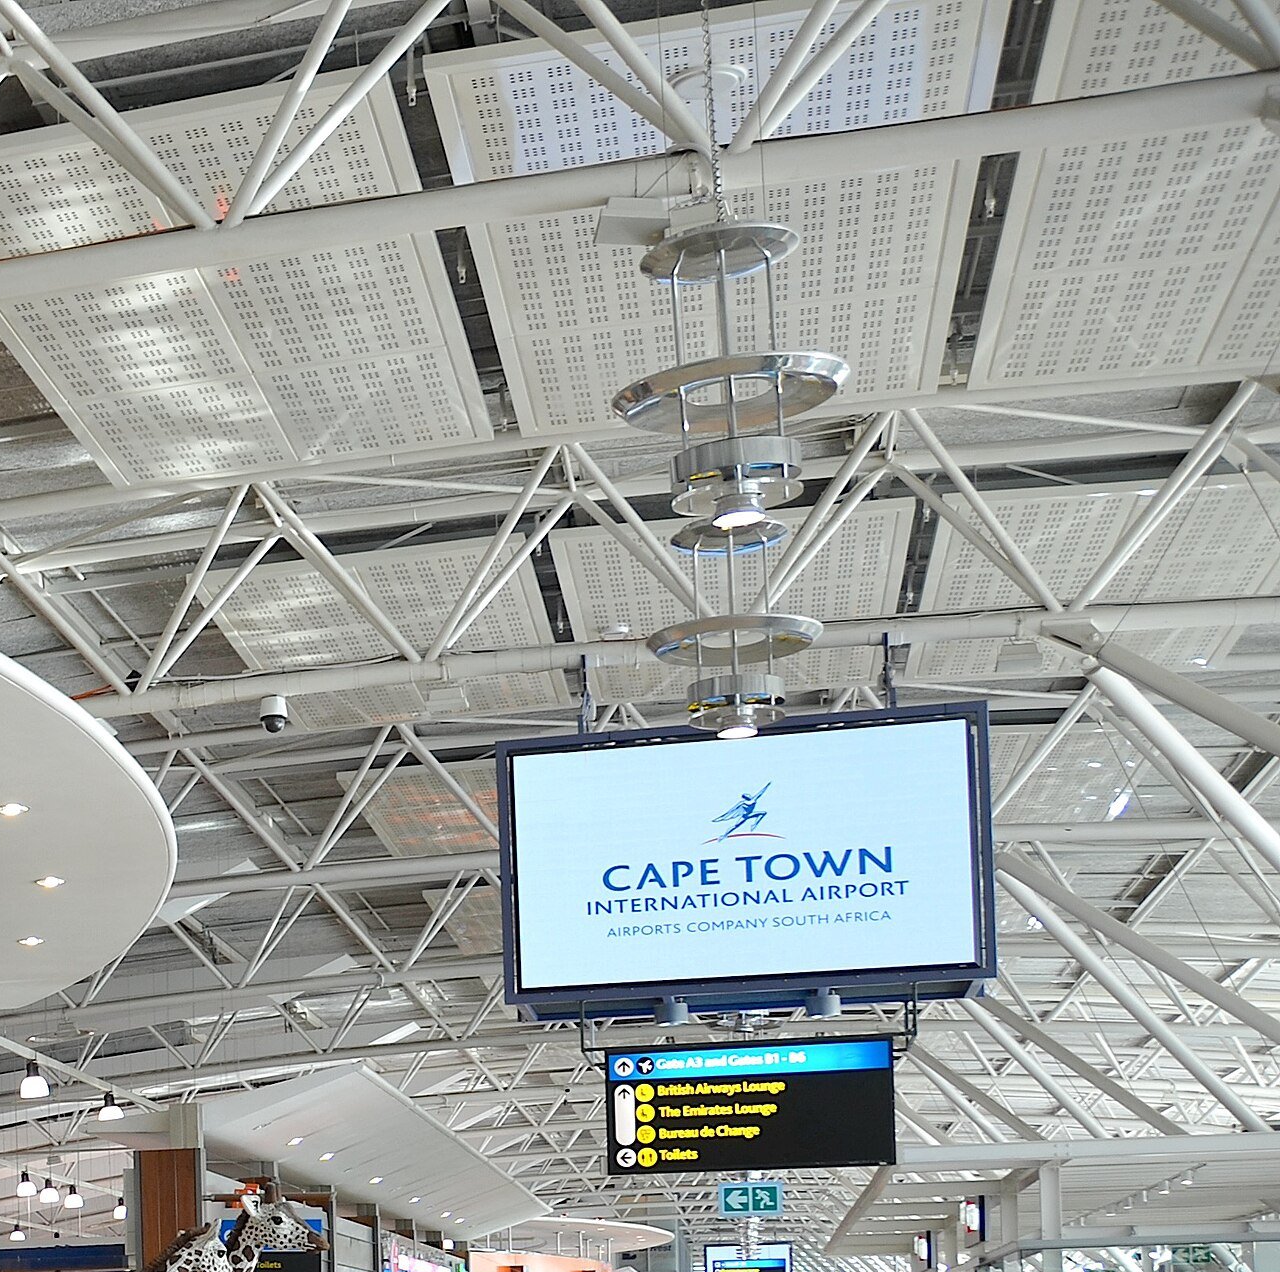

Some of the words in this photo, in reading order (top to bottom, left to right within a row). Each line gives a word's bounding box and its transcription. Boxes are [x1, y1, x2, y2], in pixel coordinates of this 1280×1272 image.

[602, 859, 721, 892] CAPE
[735, 846, 893, 883] TOWN
[587, 888, 794, 915] INTERNATIONAL
[801, 880, 909, 901] AIRPORT
[606, 923, 681, 938] AIRPORTS
[686, 917, 768, 933] COMPANY
[772, 914, 830, 928] SOUTH
[834, 910, 892, 923] AFRICA
[656, 1057, 685, 1070] Gate
[686, 1056, 703, 1068] A3
[704, 1055, 727, 1067] and
[727, 1054, 764, 1067] Gates
[657, 1083, 694, 1096] British
[695, 1082, 742, 1096] Airways
[742, 1081, 786, 1095] Lounge
[658, 1105, 681, 1118] The
[682, 1104, 733, 1117] Emirates
[734, 1103, 778, 1116] Lounge
[658, 1127, 699, 1140] Bureau
[700, 1126, 715, 1138] de
[715, 1124, 761, 1139] Change
[658, 1148, 699, 1161] Toilets
